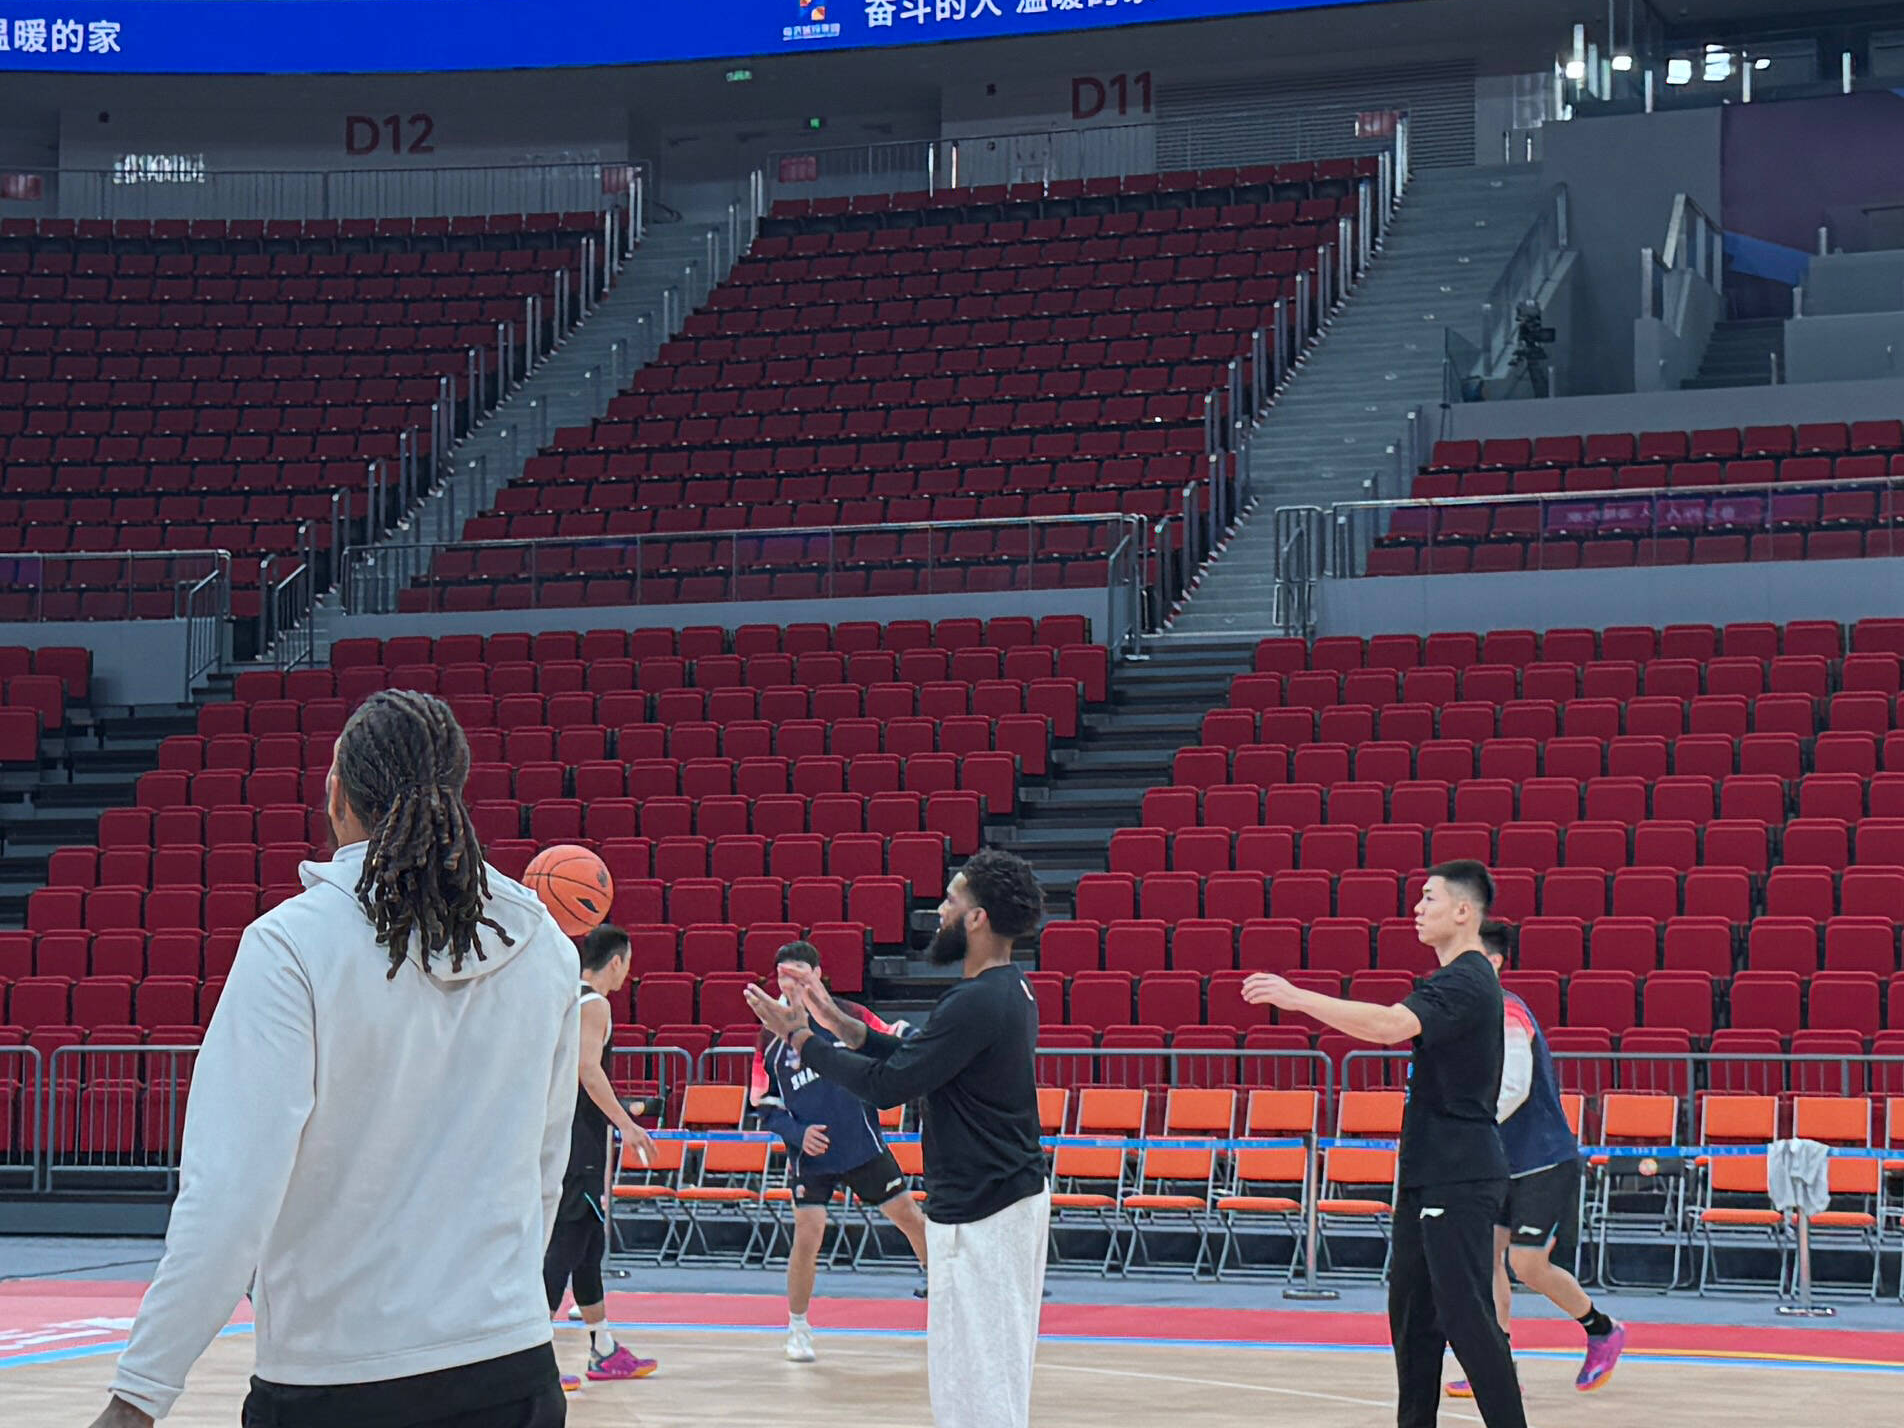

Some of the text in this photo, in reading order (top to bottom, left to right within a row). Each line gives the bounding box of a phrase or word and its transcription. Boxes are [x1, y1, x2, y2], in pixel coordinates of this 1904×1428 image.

[1071, 72, 1154, 120] D11
[345, 114, 435, 155] D12
[791, 1067, 820, 1090] SHA
